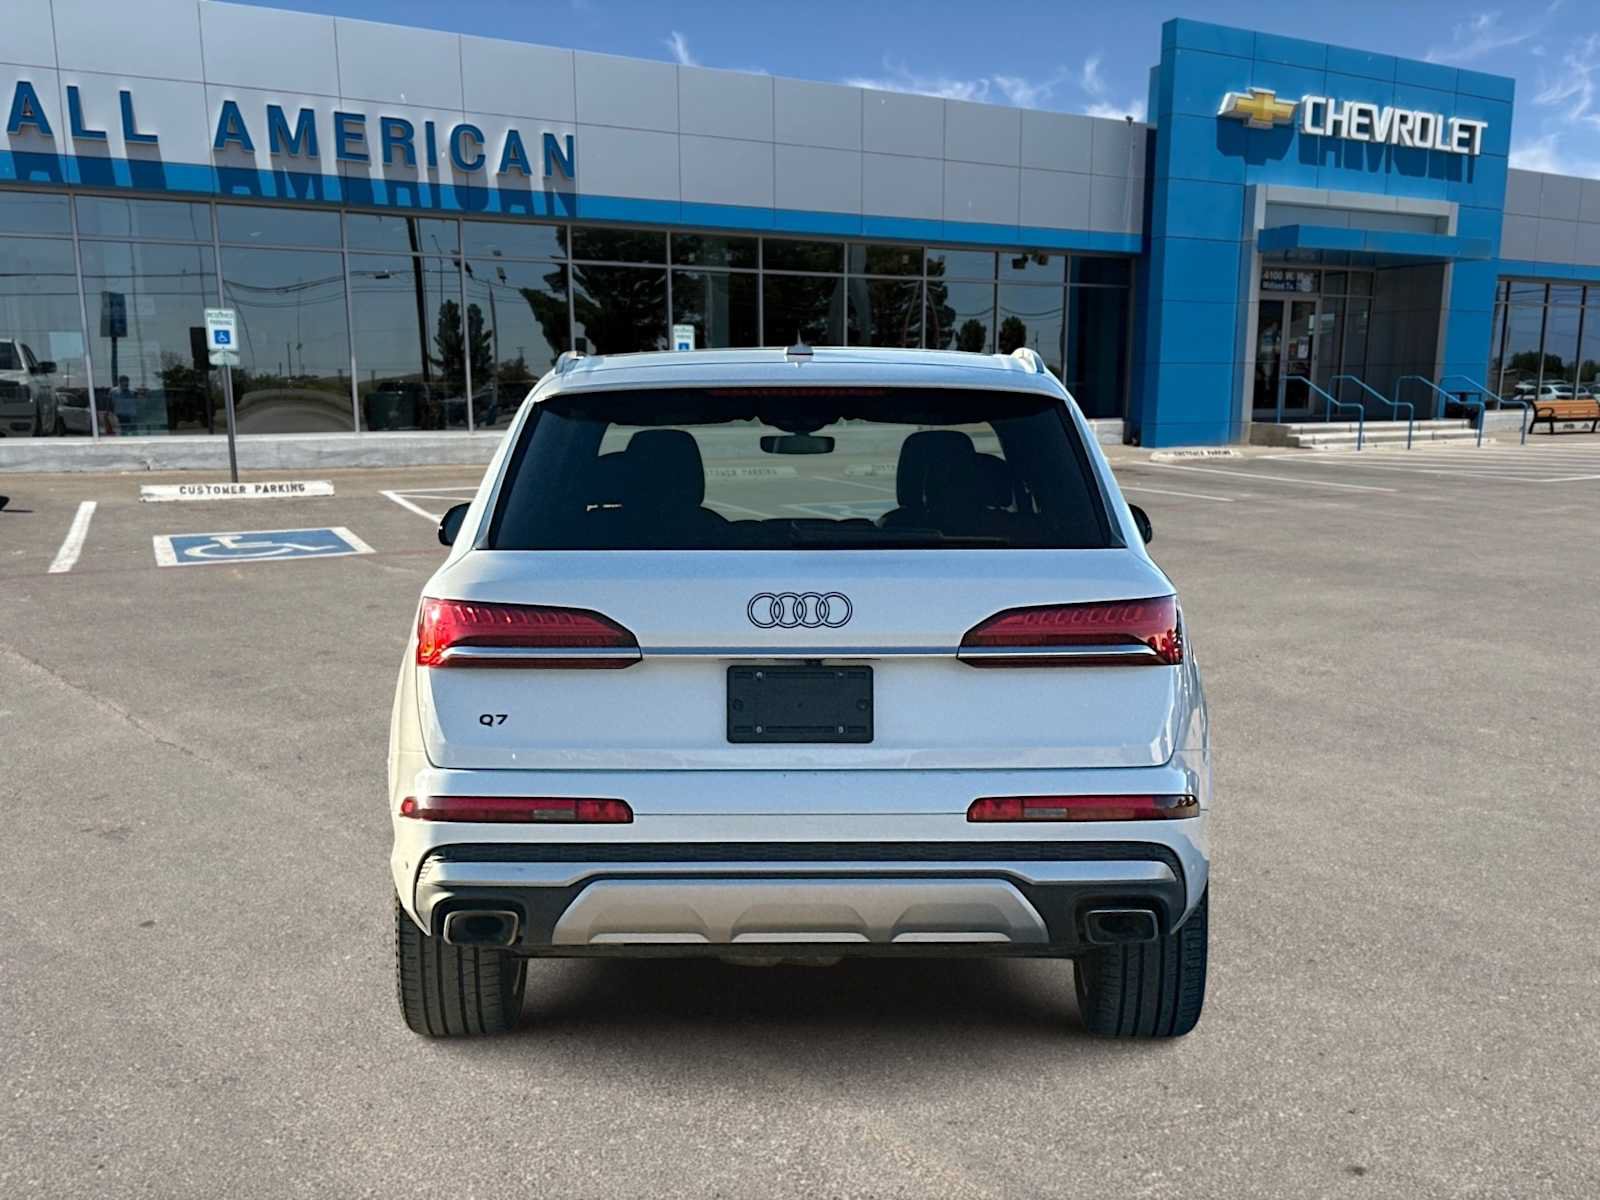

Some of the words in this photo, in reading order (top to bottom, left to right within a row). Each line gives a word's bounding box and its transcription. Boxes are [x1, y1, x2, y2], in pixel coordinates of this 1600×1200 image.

[6, 80, 158, 143] ALL
[213, 100, 576, 178] AMERICAN
[1301, 95, 1488, 156] CHEVROLET
[179, 486, 247, 495] CUSTOMER
[254, 483, 305, 494] PARKING
[479, 713, 508, 727] Q7
